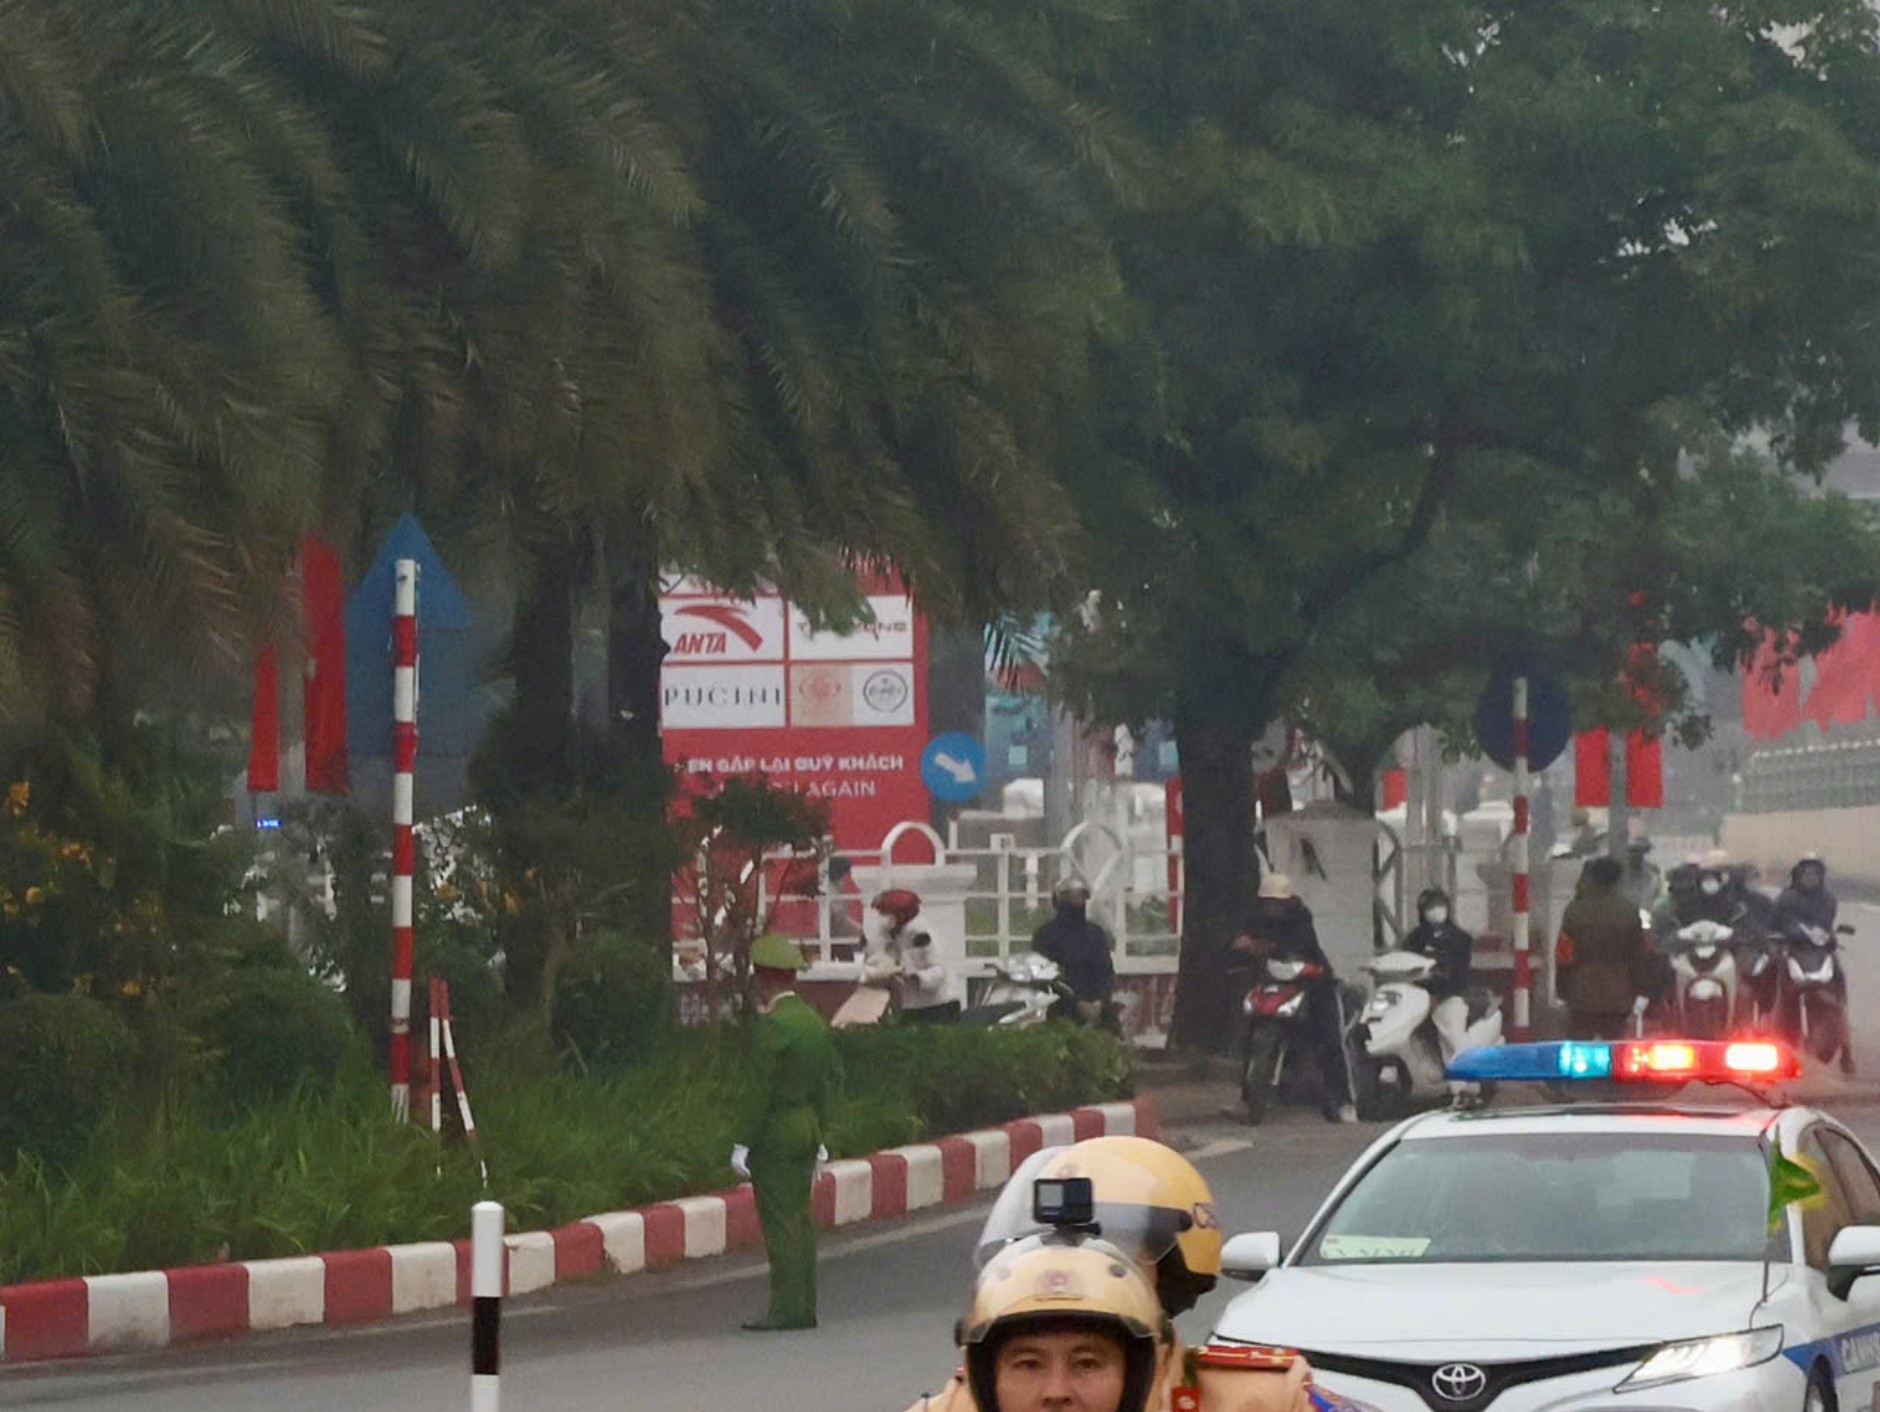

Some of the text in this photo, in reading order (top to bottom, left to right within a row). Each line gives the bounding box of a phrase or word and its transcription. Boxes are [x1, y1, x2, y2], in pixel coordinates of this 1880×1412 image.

[674, 633, 727, 653] ANTA
[794, 753, 834, 772] QUÝ
[838, 752, 904, 771] KHÁCH
[807, 780, 876, 797] AGAIN
